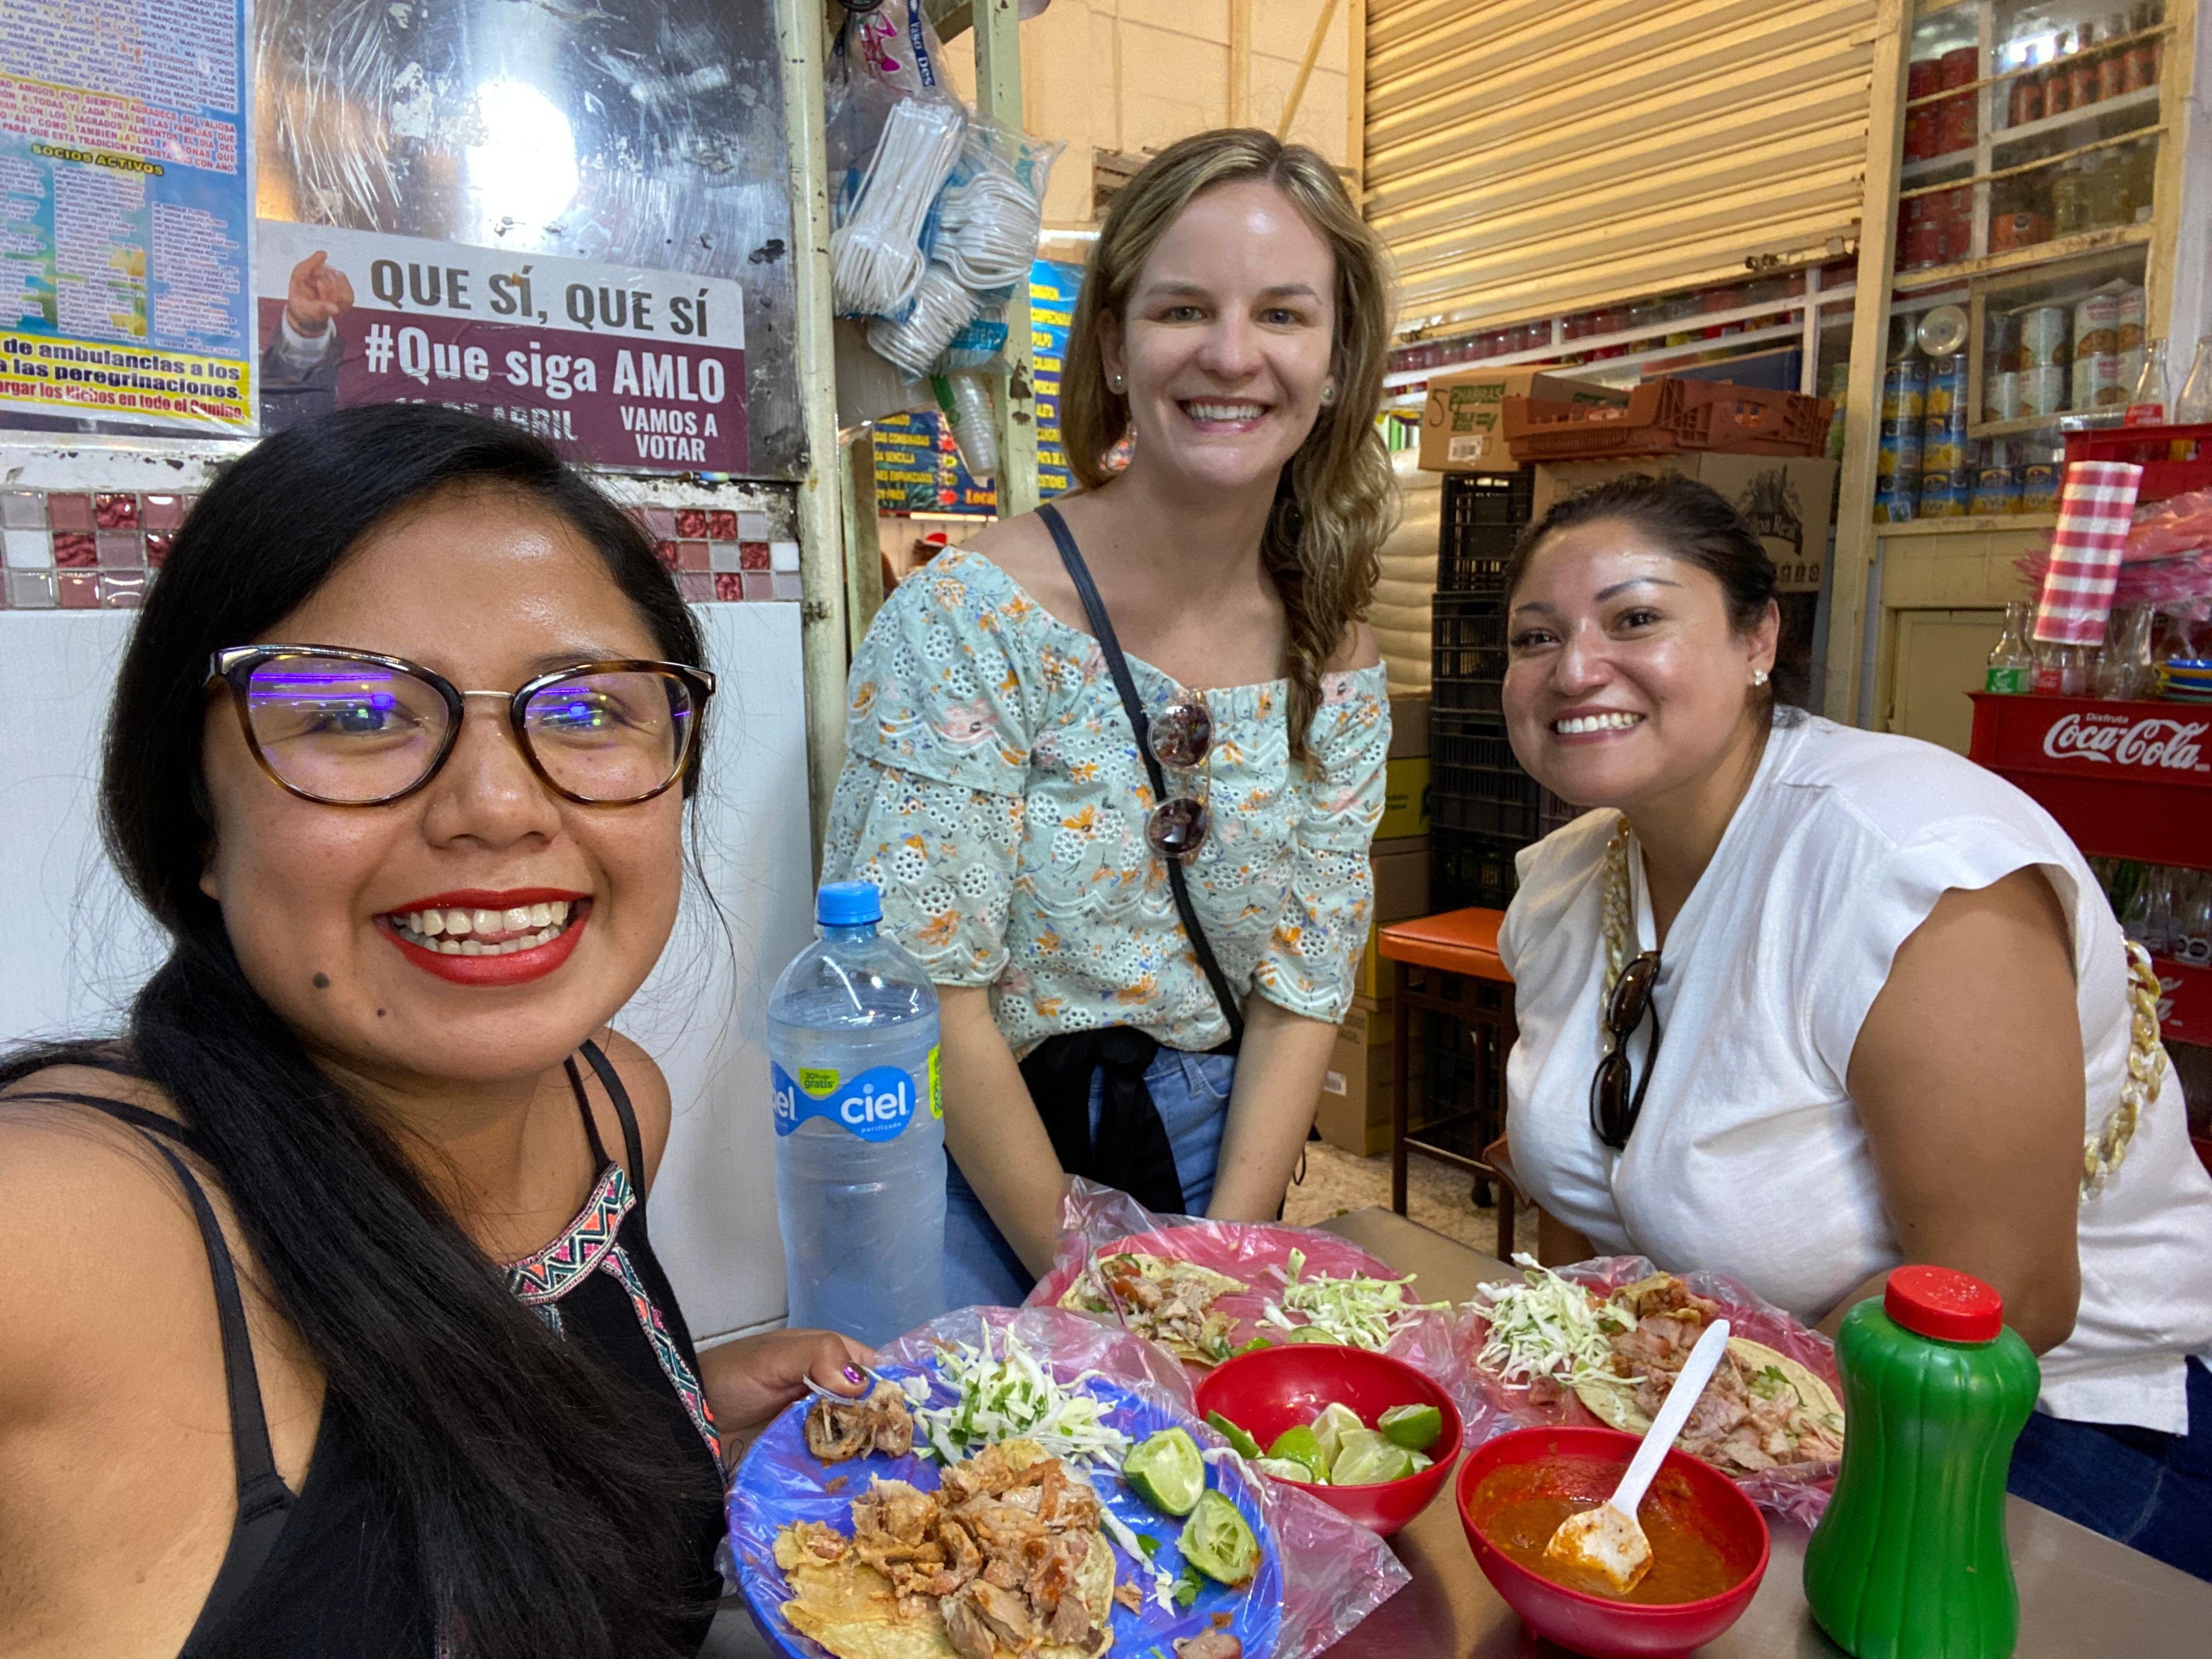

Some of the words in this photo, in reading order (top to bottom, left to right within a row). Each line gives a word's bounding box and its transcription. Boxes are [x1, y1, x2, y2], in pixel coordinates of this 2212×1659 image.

[18, 83, 54, 97] AMIGOS
[61, 91, 79, 101] POR
[86, 95, 124, 110] SIEMPRE
[131, 104, 177, 121] AGRADECE
[183, 115, 194, 124] SU
[199, 119, 234, 133] VALIOSA
[24, 104, 43, 115] CON
[49, 110, 67, 120] LOS
[74, 114, 122, 129] SAGRADOS
[128, 124, 178, 141] ALIMENTOS
[220, 143, 234, 153] DEL
[34, 96, 64, 109] TODAS
[82, 105, 105, 116] CADA
[111, 111, 129, 121] UNA
[136, 115, 146, 124] DE
[153, 119, 168, 128] LAS
[174, 123, 212, 138] FAMILIAS
[217, 133, 234, 143] QUE
[3, 122, 27, 133] PARA
[30, 127, 49, 138] QUE
[53, 131, 75, 142] ESTA
[195, 159, 212, 168] CON
[31, 143, 93, 163] SOCIOS
[95, 154, 164, 177] ACTIVOS
[38, 118, 67, 131] COMO
[138, 136, 155, 146] LAS
[217, 153, 235, 162] QUE
[371, 258, 471, 310] QUE
[488, 264, 548, 324] SÍ,
[565, 283, 654, 330] QUE
[668, 287, 708, 337] SÍ
[4, 338, 32, 355] de
[39, 345, 185, 374] ambulancias
[190, 364, 202, 376] a
[208, 363, 240, 380] los
[14, 359, 48, 377] las
[55, 366, 242, 399] peregrinaciones.
[365, 323, 488, 386] #Que
[506, 342, 597, 400] siga
[612, 349, 725, 404] AMLO
[40, 382, 62, 398] los
[119, 393, 136, 407] en
[140, 394, 171, 410] todo
[174, 398, 187, 412] el
[620, 406, 698, 436] VAMOS
[704, 413, 719, 437] A
[635, 434, 706, 462] VOTAR
[2086, 713, 2129, 724] Disfruta
[2043, 713, 2210, 769] Coca-Cola
[804, 1080, 833, 1089] gratis
[840, 1081, 906, 1124] ciel
